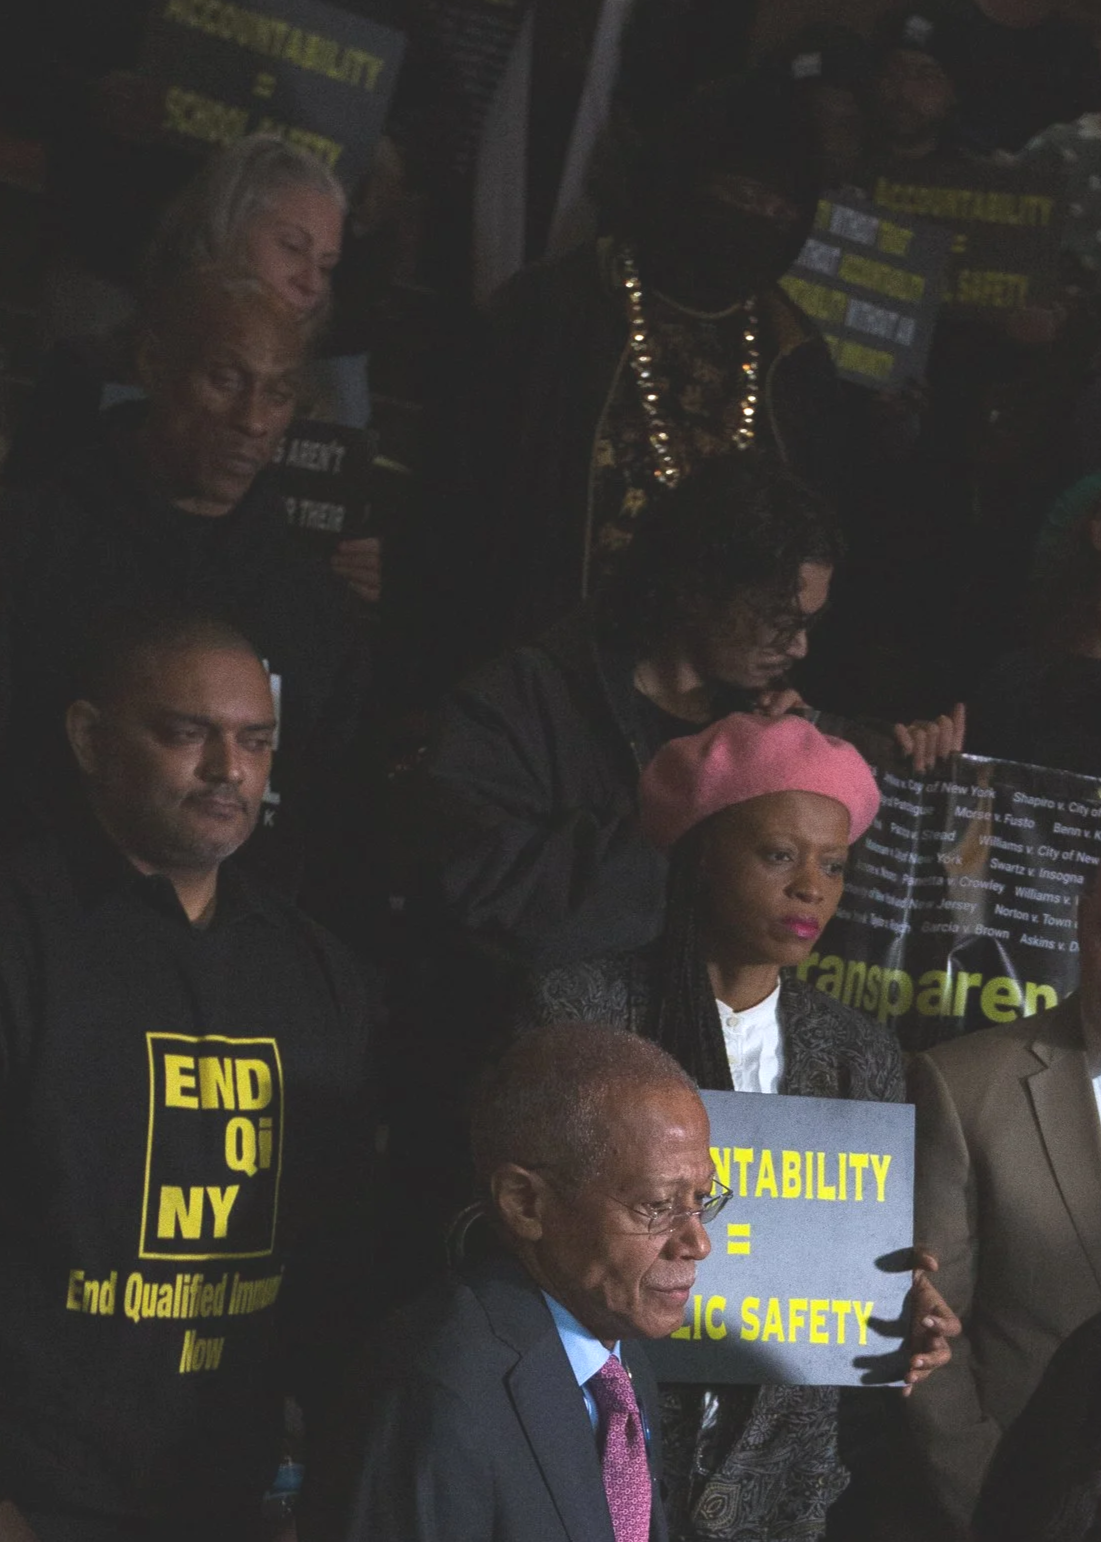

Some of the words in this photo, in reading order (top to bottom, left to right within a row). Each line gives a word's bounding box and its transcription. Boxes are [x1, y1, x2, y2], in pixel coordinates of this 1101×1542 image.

[970, 785, 997, 799] York
[1013, 791, 1055, 809] Shapiro
[1068, 802, 1088, 818] City
[954, 805, 991, 821] Morse
[1004, 813, 1036, 829] Fusto
[1053, 822, 1081, 838] Benn
[937, 852, 964, 866] York
[979, 834, 1025, 853] Williams
[1038, 845, 1059, 861] City
[1062, 848, 1076, 861] of
[1077, 852, 1101, 867] New
[990, 857, 1026, 876] Swartz
[1039, 868, 1085, 886] Insogna
[959, 876, 1006, 895] Crowley
[1014, 886, 1063, 904] Williams
[937, 898, 978, 912] Jersey
[994, 903, 1030, 921] Norton
[1042, 912, 1071, 928] Town
[973, 923, 1010, 940] Brown
[1019, 932, 1057, 951] Askins
[796, 952, 1058, 1023] ransparen
[164, 1054, 273, 1110] END
[225, 1117, 273, 1177] Qi
[710, 1147, 892, 1202] NTABILITY
[157, 1184, 240, 1240] NY
[66, 1270, 118, 1318] End
[123, 1271, 227, 1324] Qualified
[741, 1296, 874, 1345] SAFETY
[179, 1329, 225, 1374] Now
